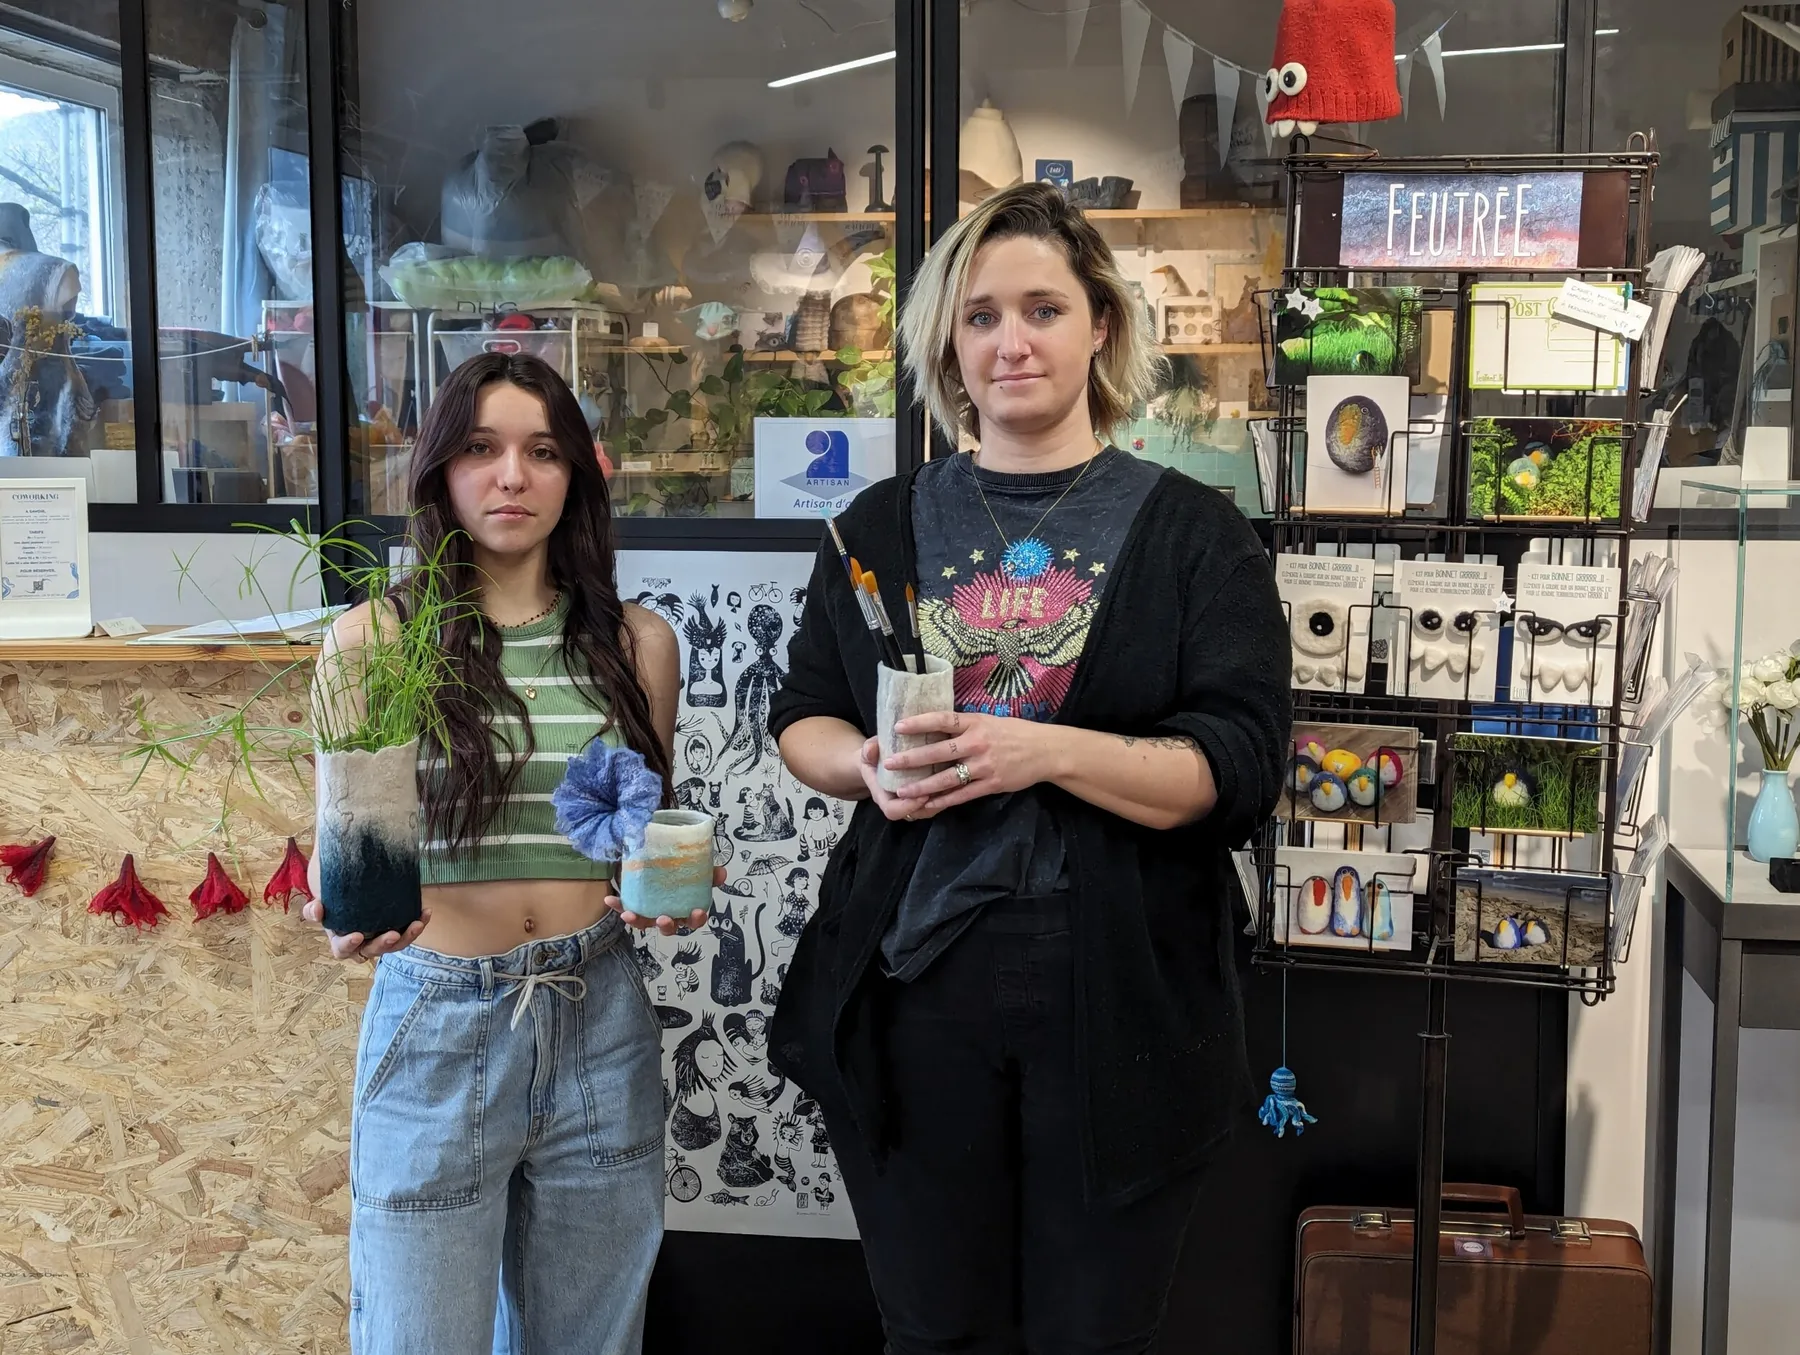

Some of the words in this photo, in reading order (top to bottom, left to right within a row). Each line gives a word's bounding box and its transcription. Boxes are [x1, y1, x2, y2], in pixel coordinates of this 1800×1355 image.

[793, 499, 833, 508] Artisan
[1309, 562, 1330, 571] BONNET
[1435, 569, 1457, 579] BONNET
[1552, 572, 1574, 581] BONNET
[981, 587, 1049, 619] LIFE
